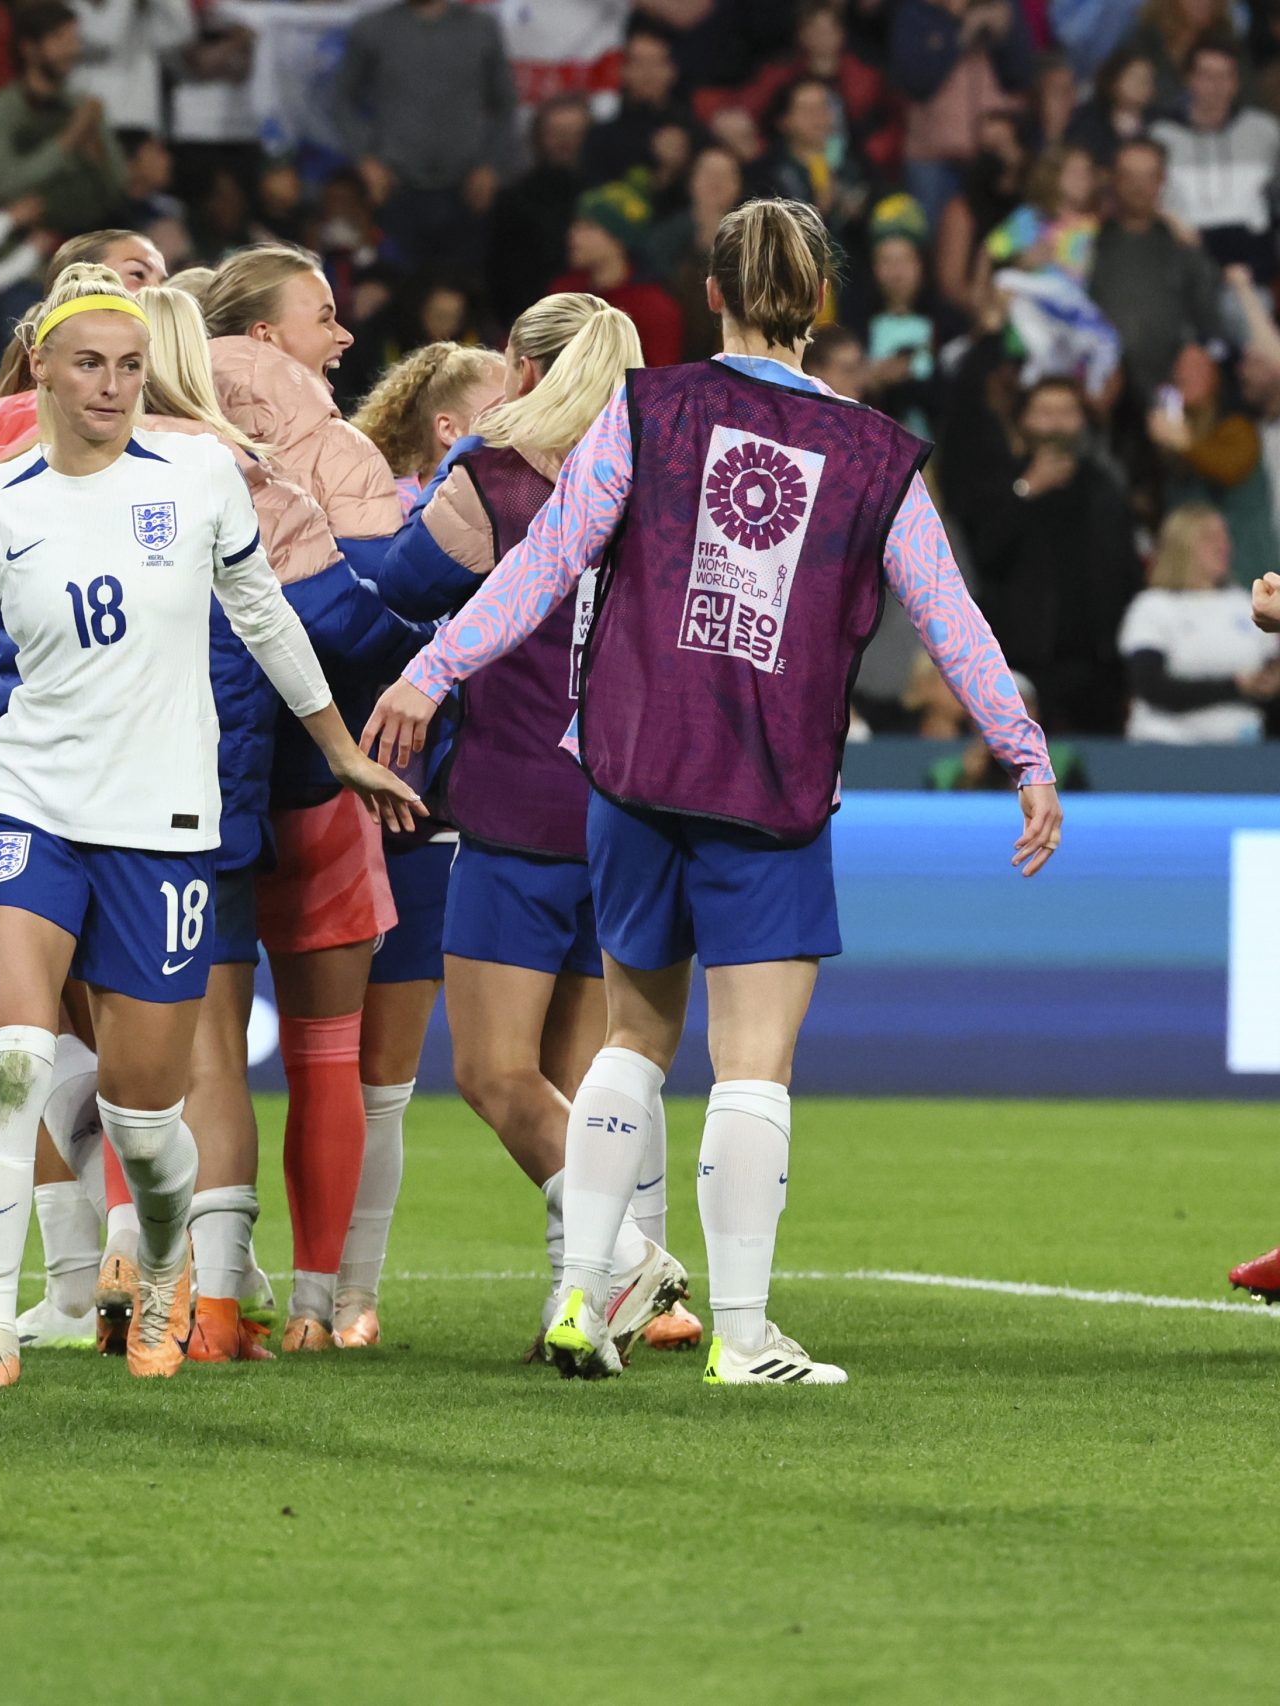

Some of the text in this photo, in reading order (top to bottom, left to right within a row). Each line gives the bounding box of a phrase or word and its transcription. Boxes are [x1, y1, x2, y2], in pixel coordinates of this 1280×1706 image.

[698, 541, 729, 559] FIFA
[696, 571, 768, 600] WORLD CUP
[697, 558, 758, 584] WOMEN'S
[65, 574, 127, 649] 18
[690, 594, 731, 622] AU
[686, 619, 726, 648] NZ
[159, 879, 209, 953] 18
